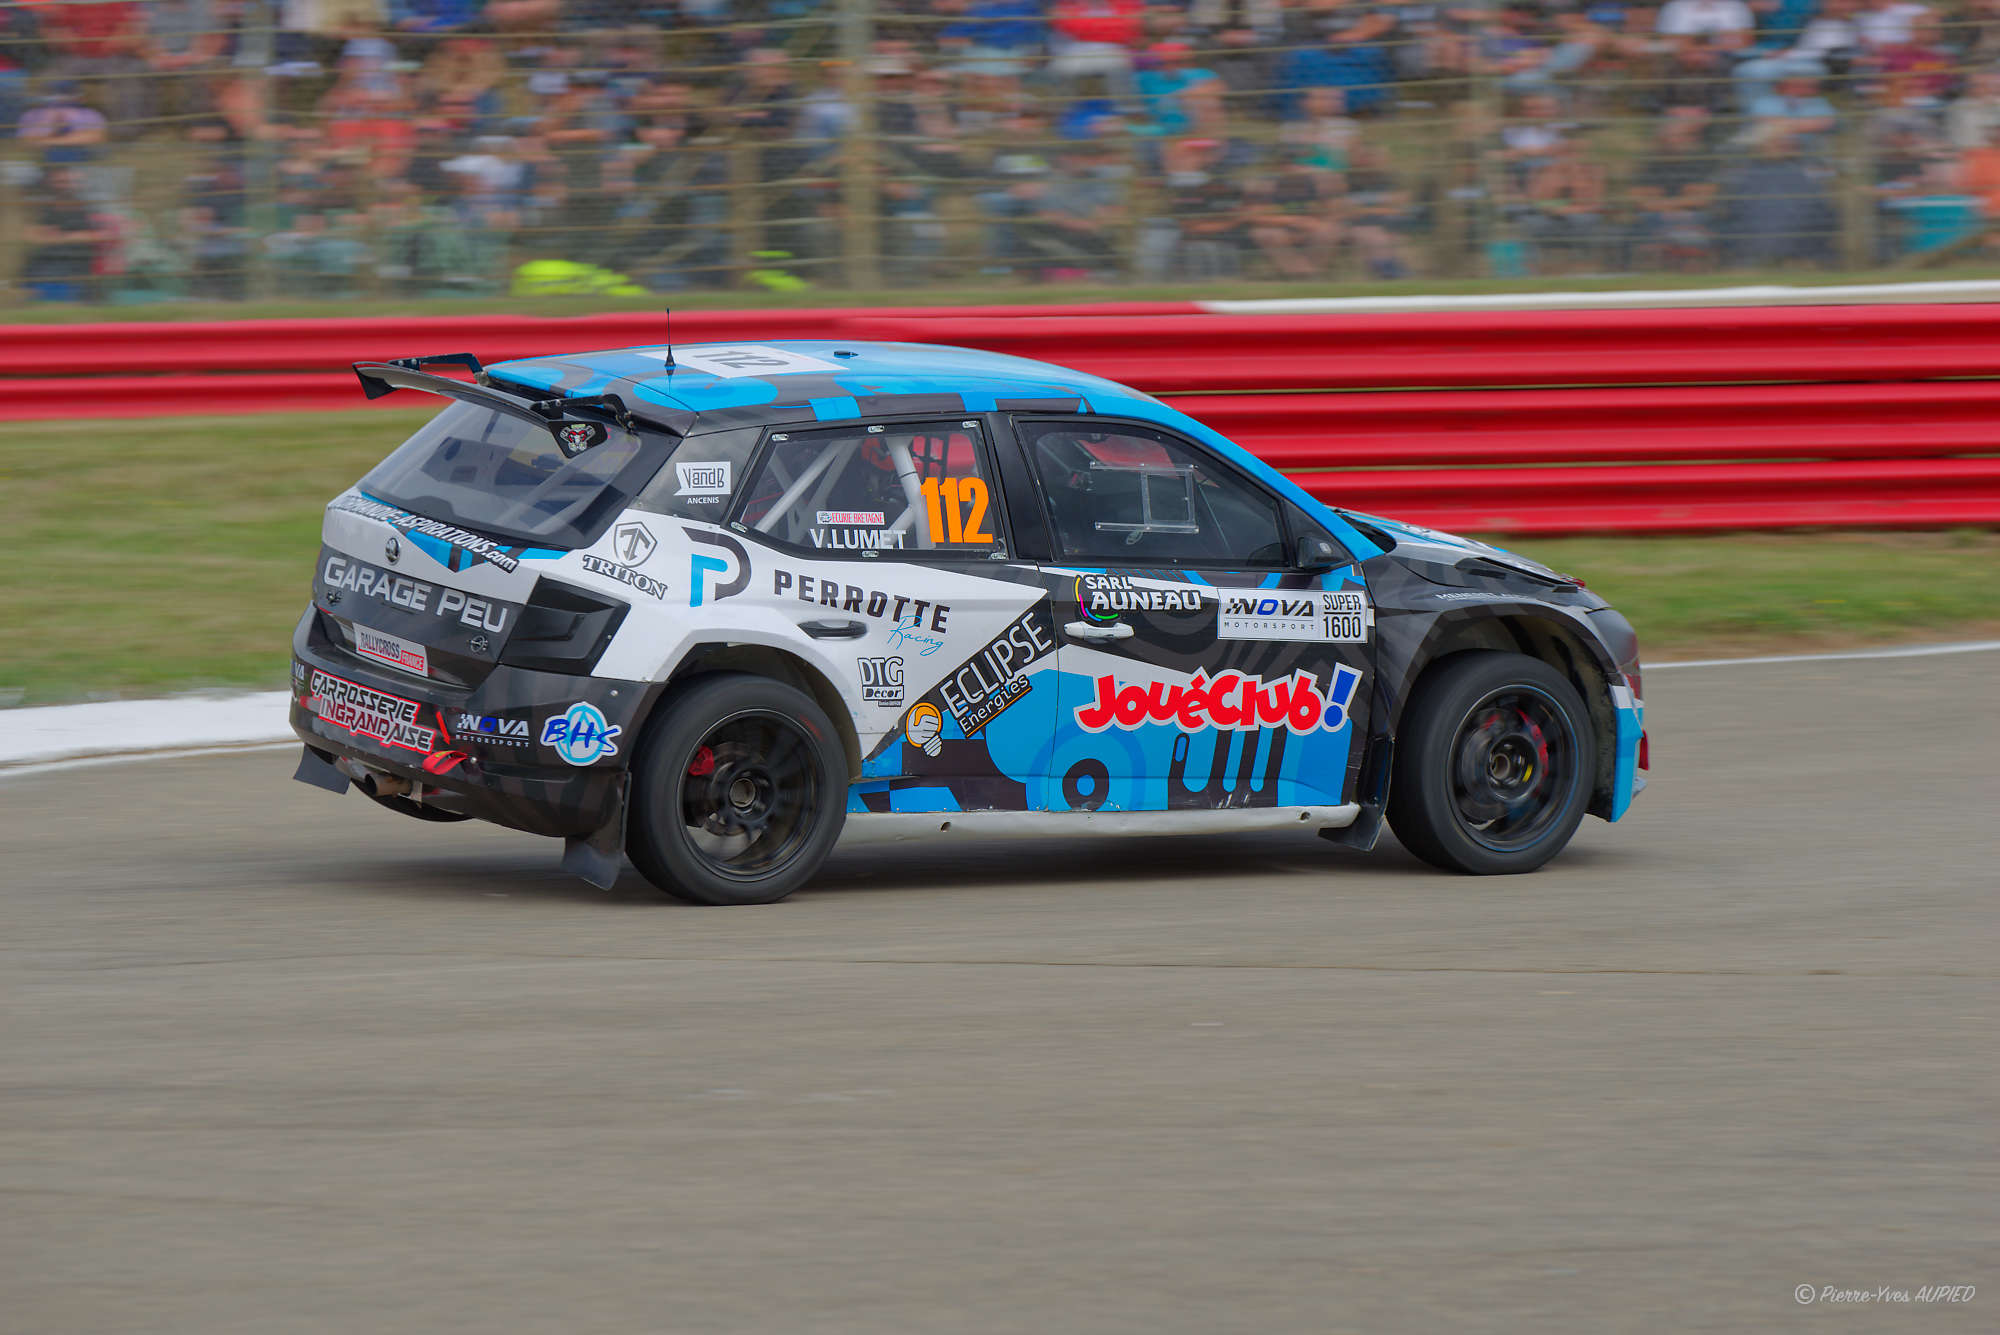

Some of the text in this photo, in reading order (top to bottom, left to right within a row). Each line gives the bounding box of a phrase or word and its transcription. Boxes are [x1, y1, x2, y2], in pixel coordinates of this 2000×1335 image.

[692, 350, 790, 369] 112
[687, 496, 720, 505] ANCENIS
[920, 476, 994, 544] 112
[831, 512, 884, 524] ECURIE BRETAGNE
[809, 528, 907, 550] V.LUMET
[582, 554, 668, 601] TRITON
[1085, 575, 1132, 590] SARL
[324, 556, 507, 633] GARAGE PEU
[774, 568, 951, 634] PERROTTE
[1091, 590, 1201, 611] AUNEAU
[1323, 593, 1361, 610] SUPER
[887, 615, 944, 657] Racing
[1224, 621, 1315, 631] MOTORSPORT
[1323, 616, 1361, 638] 1600
[360, 632, 423, 670] RALLYCROSS FRANCE
[857, 656, 904, 686] DTG
[939, 611, 1052, 719] ECLIPSE
[312, 673, 416, 723] CARROSSERIE
[865, 687, 901, 698] Décor
[959, 674, 1029, 733] Energies
[320, 696, 433, 750] INGRANDAISE
[456, 734, 530, 747] MOTORSPORT
